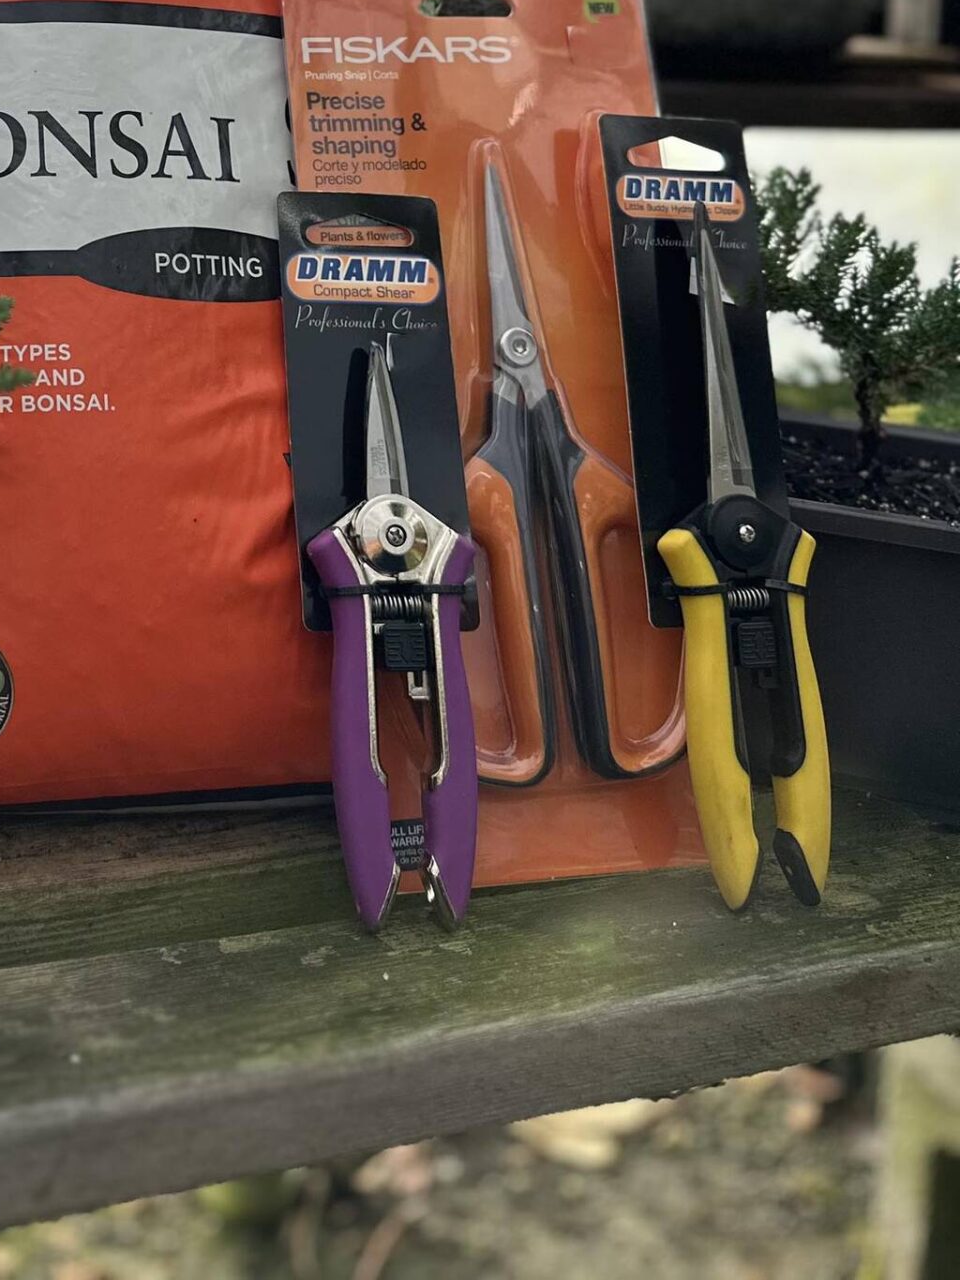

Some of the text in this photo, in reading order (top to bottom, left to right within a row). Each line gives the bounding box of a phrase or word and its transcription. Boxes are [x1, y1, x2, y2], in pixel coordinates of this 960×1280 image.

[301, 36, 512, 64] FISKARS
[304, 71, 343, 81] Pruning
[344, 70, 367, 80] Snip
[306, 91, 385, 110] Precise
[310, 112, 427, 135] trimming &
[312, 136, 396, 158] shaping
[312, 158, 427, 174] Corte y modelado
[315, 174, 362, 188] preciso
[625, 177, 733, 203] DRAMM
[321, 231, 407, 242] Plants & flowers
[155, 253, 263, 279] POTTING
[296, 255, 428, 285] DRAMM
[313, 284, 416, 299] Compact Shear
[392, 306, 439, 330] Choice
[0, 343, 71, 363] TYPES
[35, 368, 85, 387] AND
[21, 393, 116, 413] BONSAI.
[408, 824, 424, 835] LIF
[391, 835, 424, 848] WARRA
